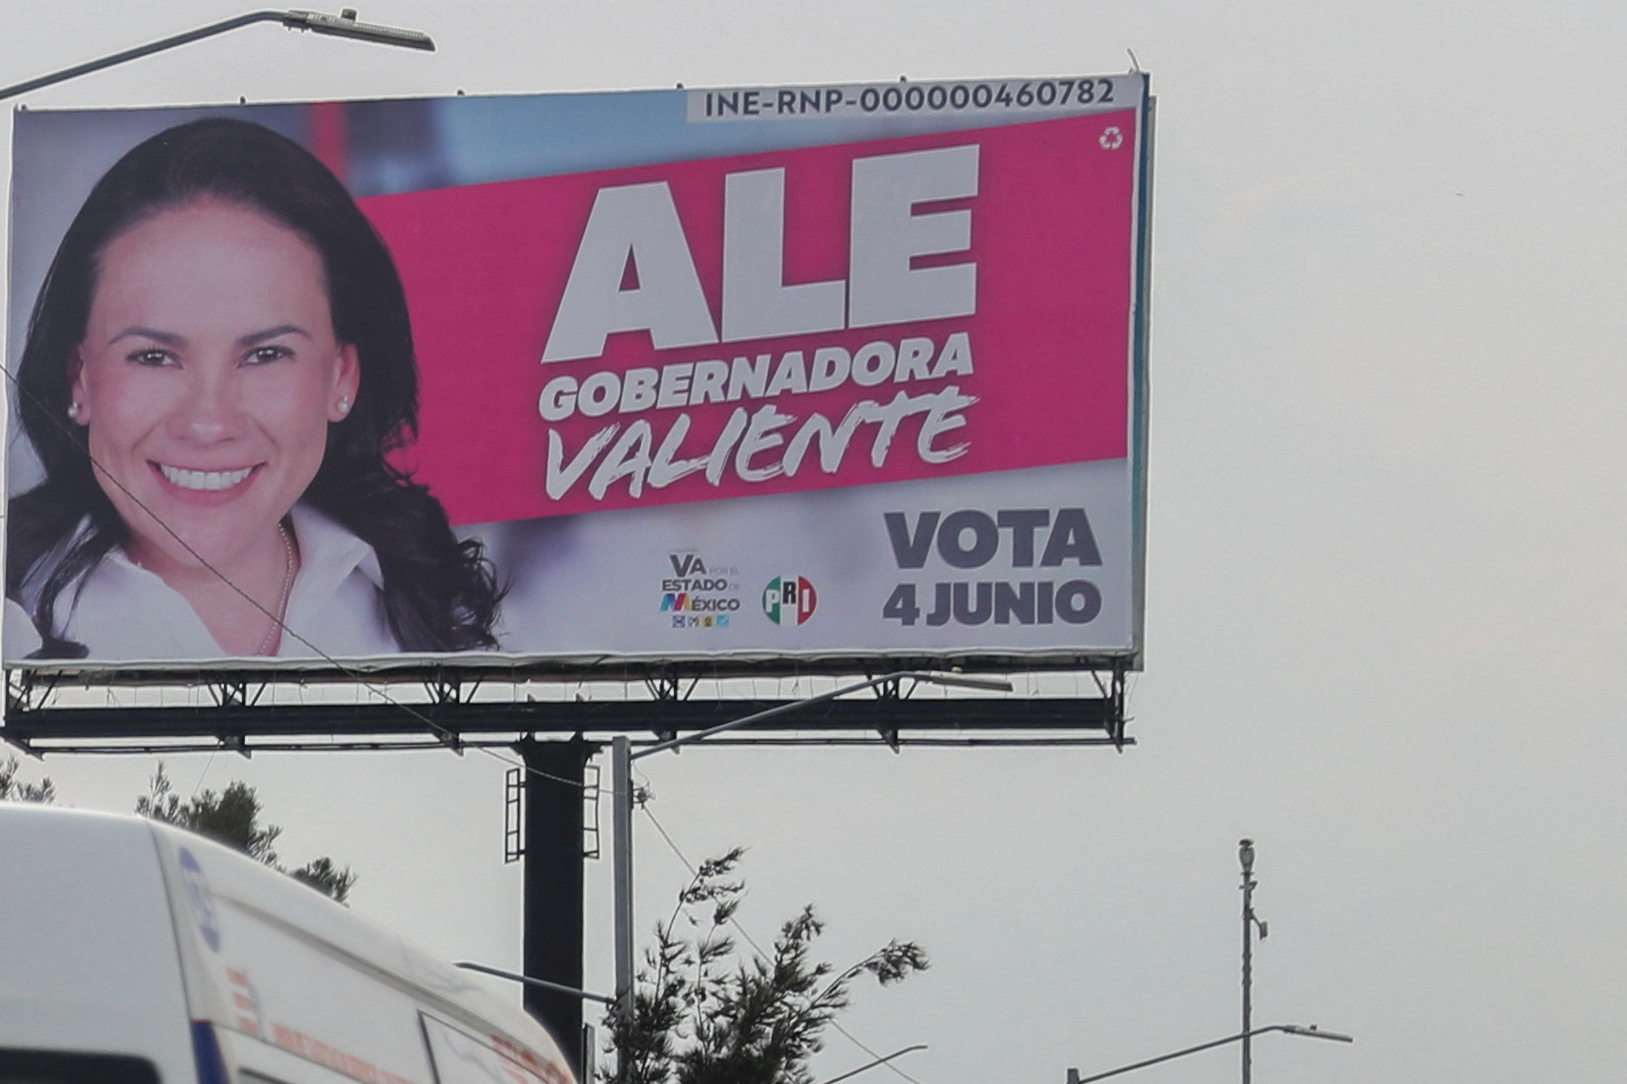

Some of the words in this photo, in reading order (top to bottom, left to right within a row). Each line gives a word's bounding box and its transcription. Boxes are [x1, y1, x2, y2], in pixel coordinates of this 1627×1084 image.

[705, 78, 1115, 117] INE-RNP-000000460782
[540, 143, 981, 364] ALE
[538, 331, 975, 421] GOBERNADORA
[545, 384, 981, 501] VALIENTE
[883, 507, 1104, 569] VOTA
[661, 578, 728, 592] ESTADO
[669, 554, 707, 578] VA
[660, 592, 741, 612] MÉXICO
[765, 580, 811, 613] PRI
[882, 581, 921, 627] 4
[925, 579, 1103, 626] JUNIO
